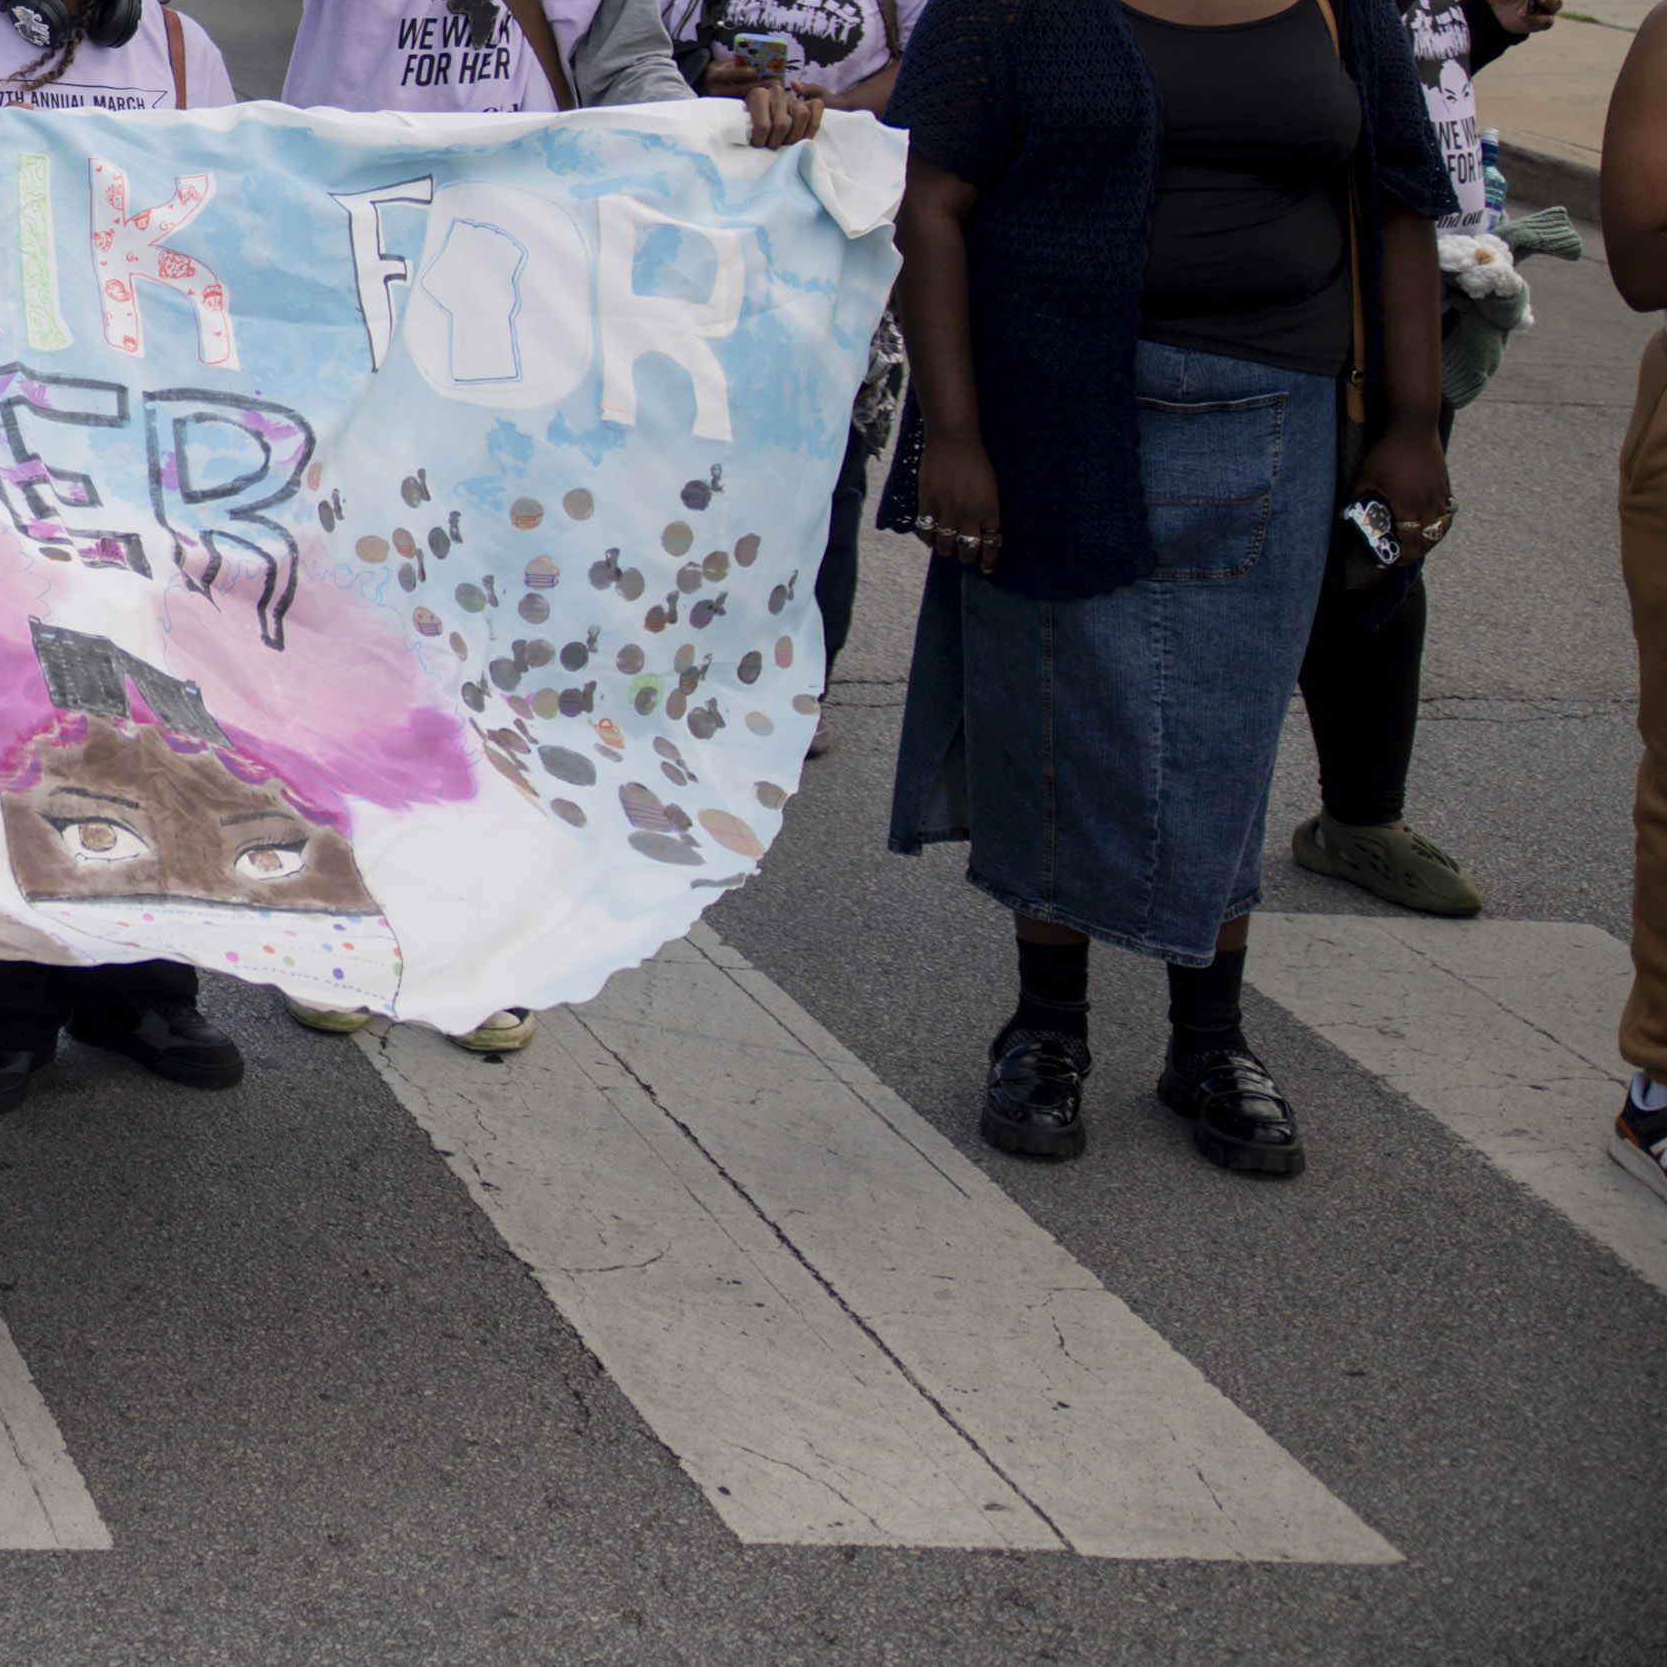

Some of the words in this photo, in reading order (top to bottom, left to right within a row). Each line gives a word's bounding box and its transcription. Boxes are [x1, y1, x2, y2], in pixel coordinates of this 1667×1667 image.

[398, 18, 438, 50] WE
[401, 52, 452, 87] FOR
[458, 47, 510, 84] HER
[31, 91, 85, 108] ANNUAL
[93, 96, 145, 110] MARCH
[1447, 152, 1476, 184] FOR
[328, 174, 752, 442] FOR
